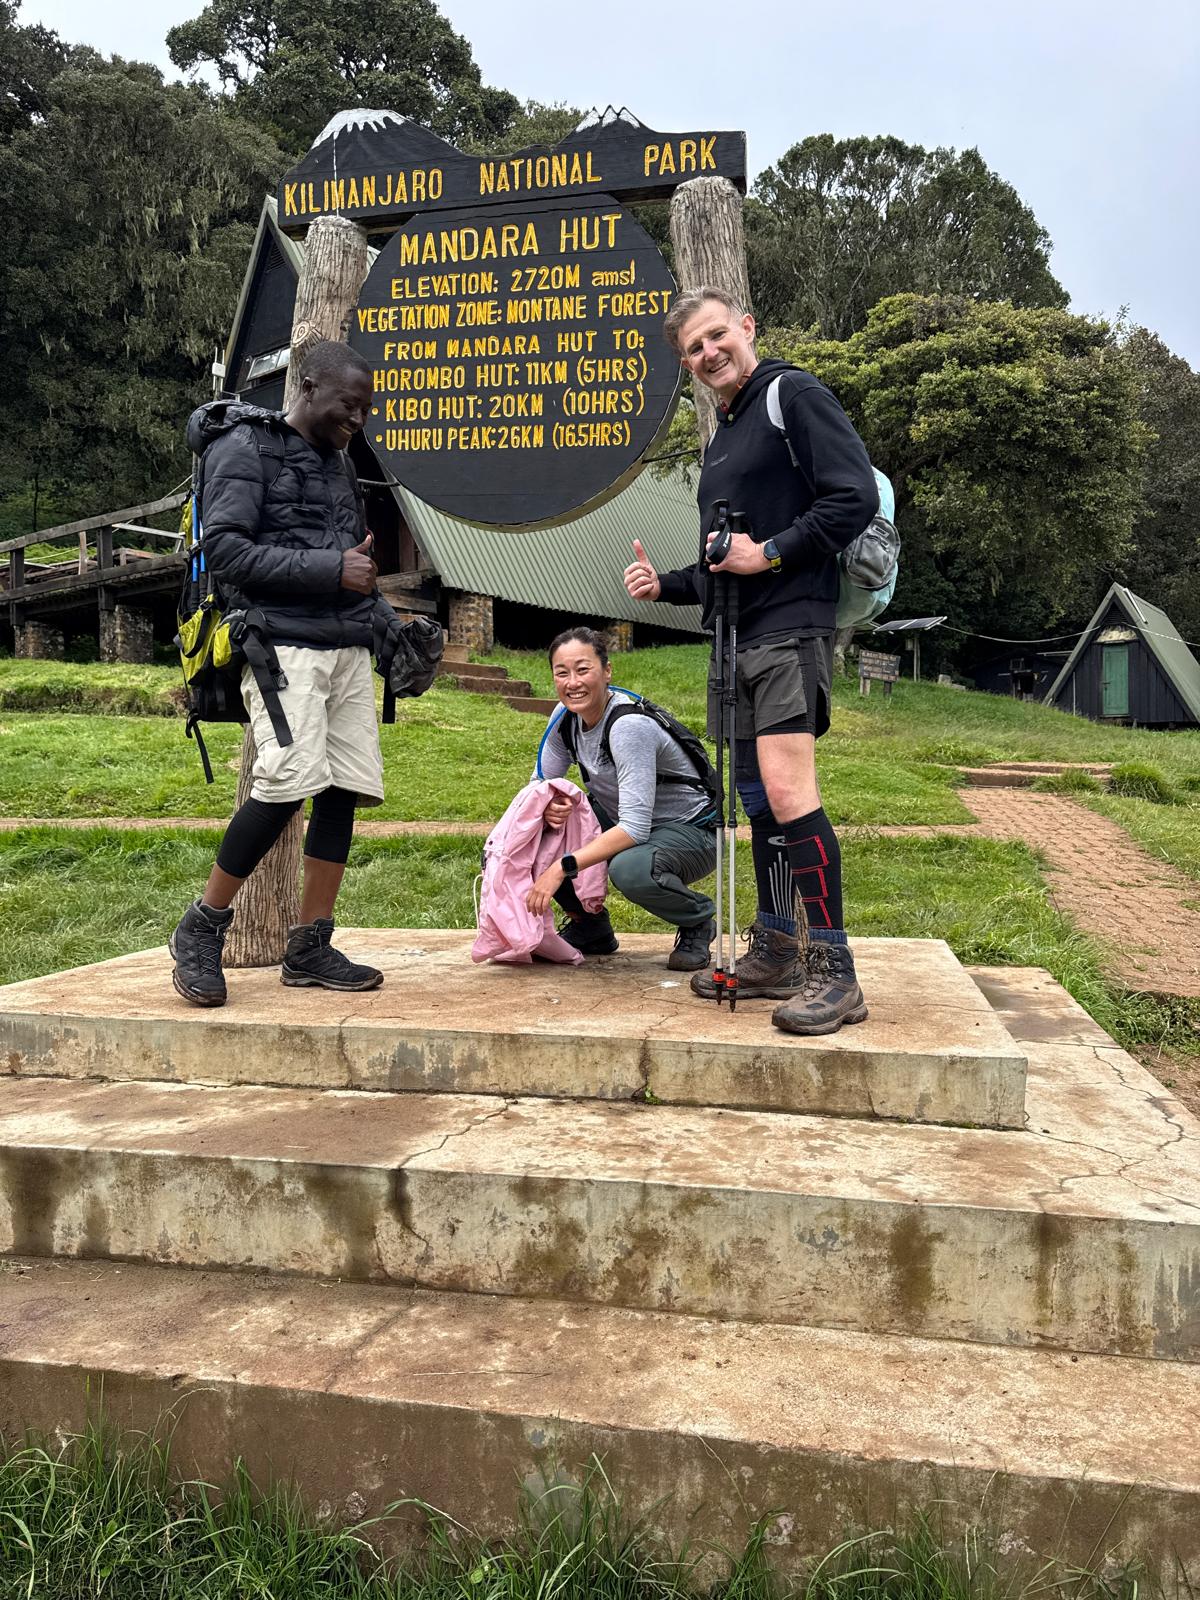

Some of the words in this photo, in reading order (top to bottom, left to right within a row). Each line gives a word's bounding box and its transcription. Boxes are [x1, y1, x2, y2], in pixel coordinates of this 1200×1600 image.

[285, 169, 442, 215] KILIMANJARO
[480, 152, 601, 194] NATIONAL
[645, 136, 716, 176] PARK
[400, 224, 538, 266] MANDARA
[560, 214, 621, 252] HUT
[392, 272, 498, 300] ELEVATION:
[511, 264, 580, 292] 2720M
[592, 260, 635, 286] amsl
[358, 304, 449, 332] VEGETATION
[456, 300, 502, 327] ZONE:
[507, 295, 586, 324] MONTANE
[599, 290, 671, 317] FOREST
[384, 341, 436, 360] FROM
[447, 335, 540, 358] MANDARA
[558, 331, 596, 352] HUT
[613, 329, 644, 349] TO:
[373, 366, 465, 392] HOROMBO
[477, 363, 519, 387] HUT:
[526, 361, 567, 385] 11KM
[577, 352, 647, 386] (5HRS)
[386, 398, 431, 421] KIBO
[439, 395, 482, 419] HUT:
[489, 393, 543, 418] 20KM
[563, 384, 644, 416] (10HRS)
[386, 429, 442, 449] UHURU
